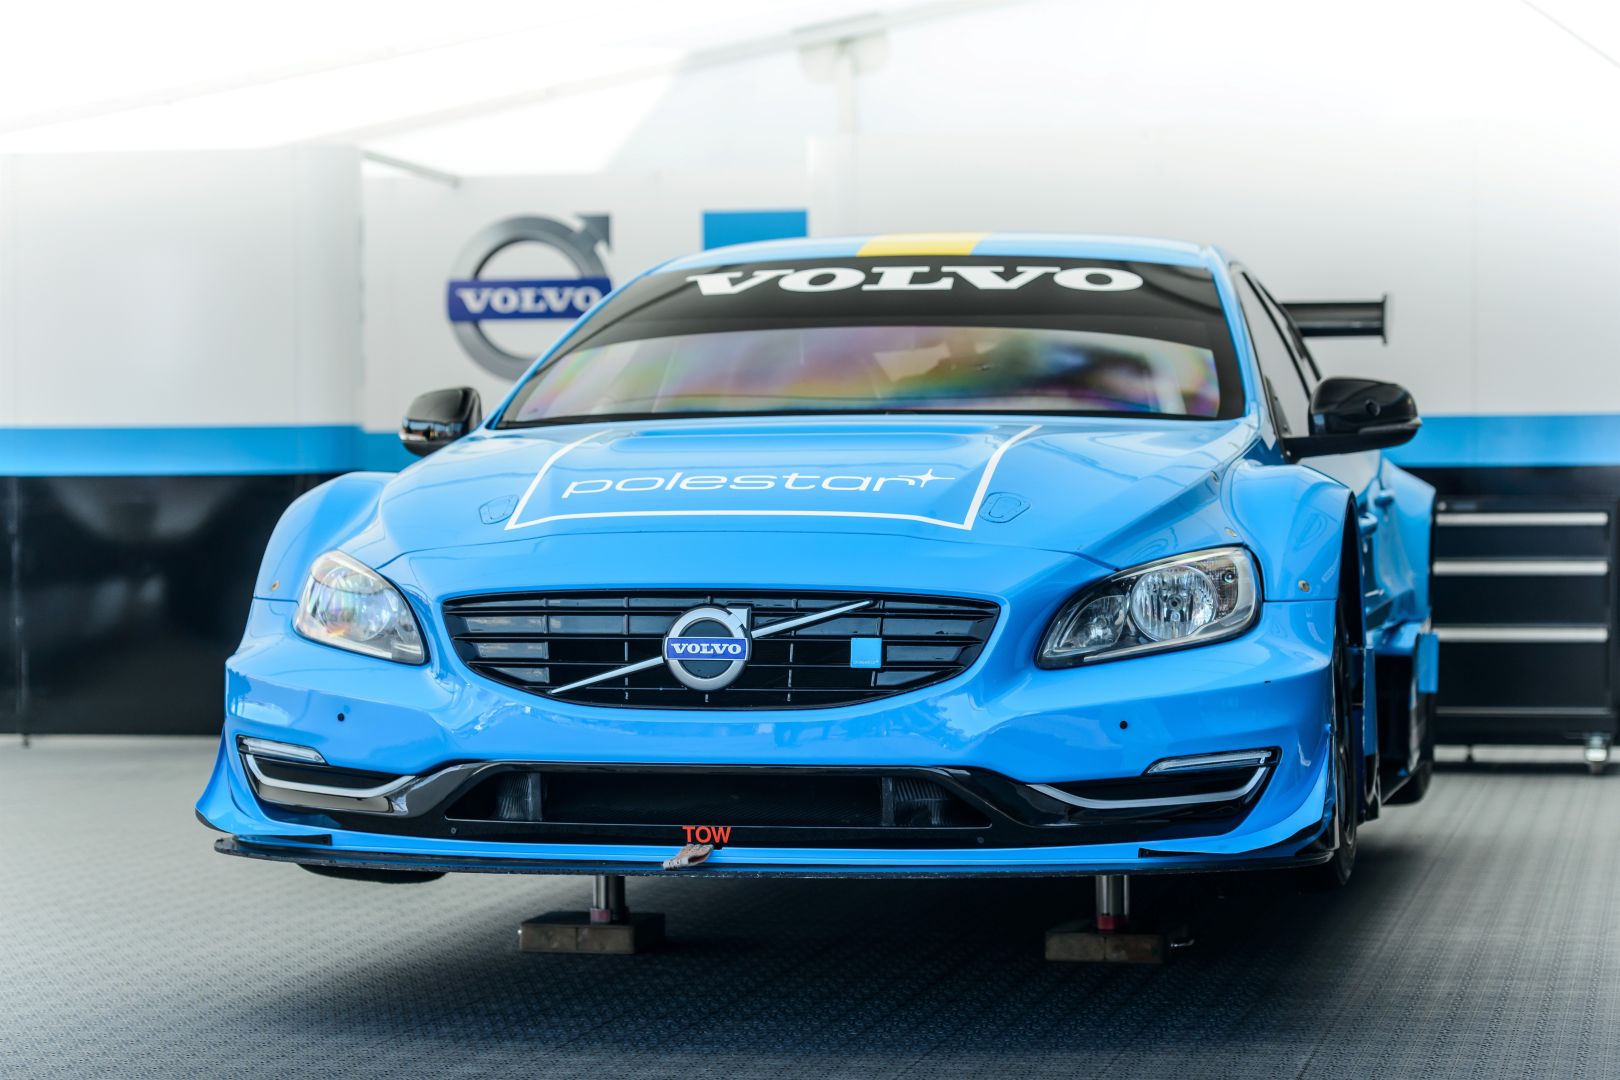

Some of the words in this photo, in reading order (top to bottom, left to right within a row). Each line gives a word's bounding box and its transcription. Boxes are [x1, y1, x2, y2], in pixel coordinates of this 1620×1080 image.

[685, 265, 1144, 297] VOLVO
[455, 285, 602, 314] VOLVO
[561, 471, 916, 499] polestar
[670, 643, 742, 655] VOLVO
[682, 825, 731, 844] TOW
